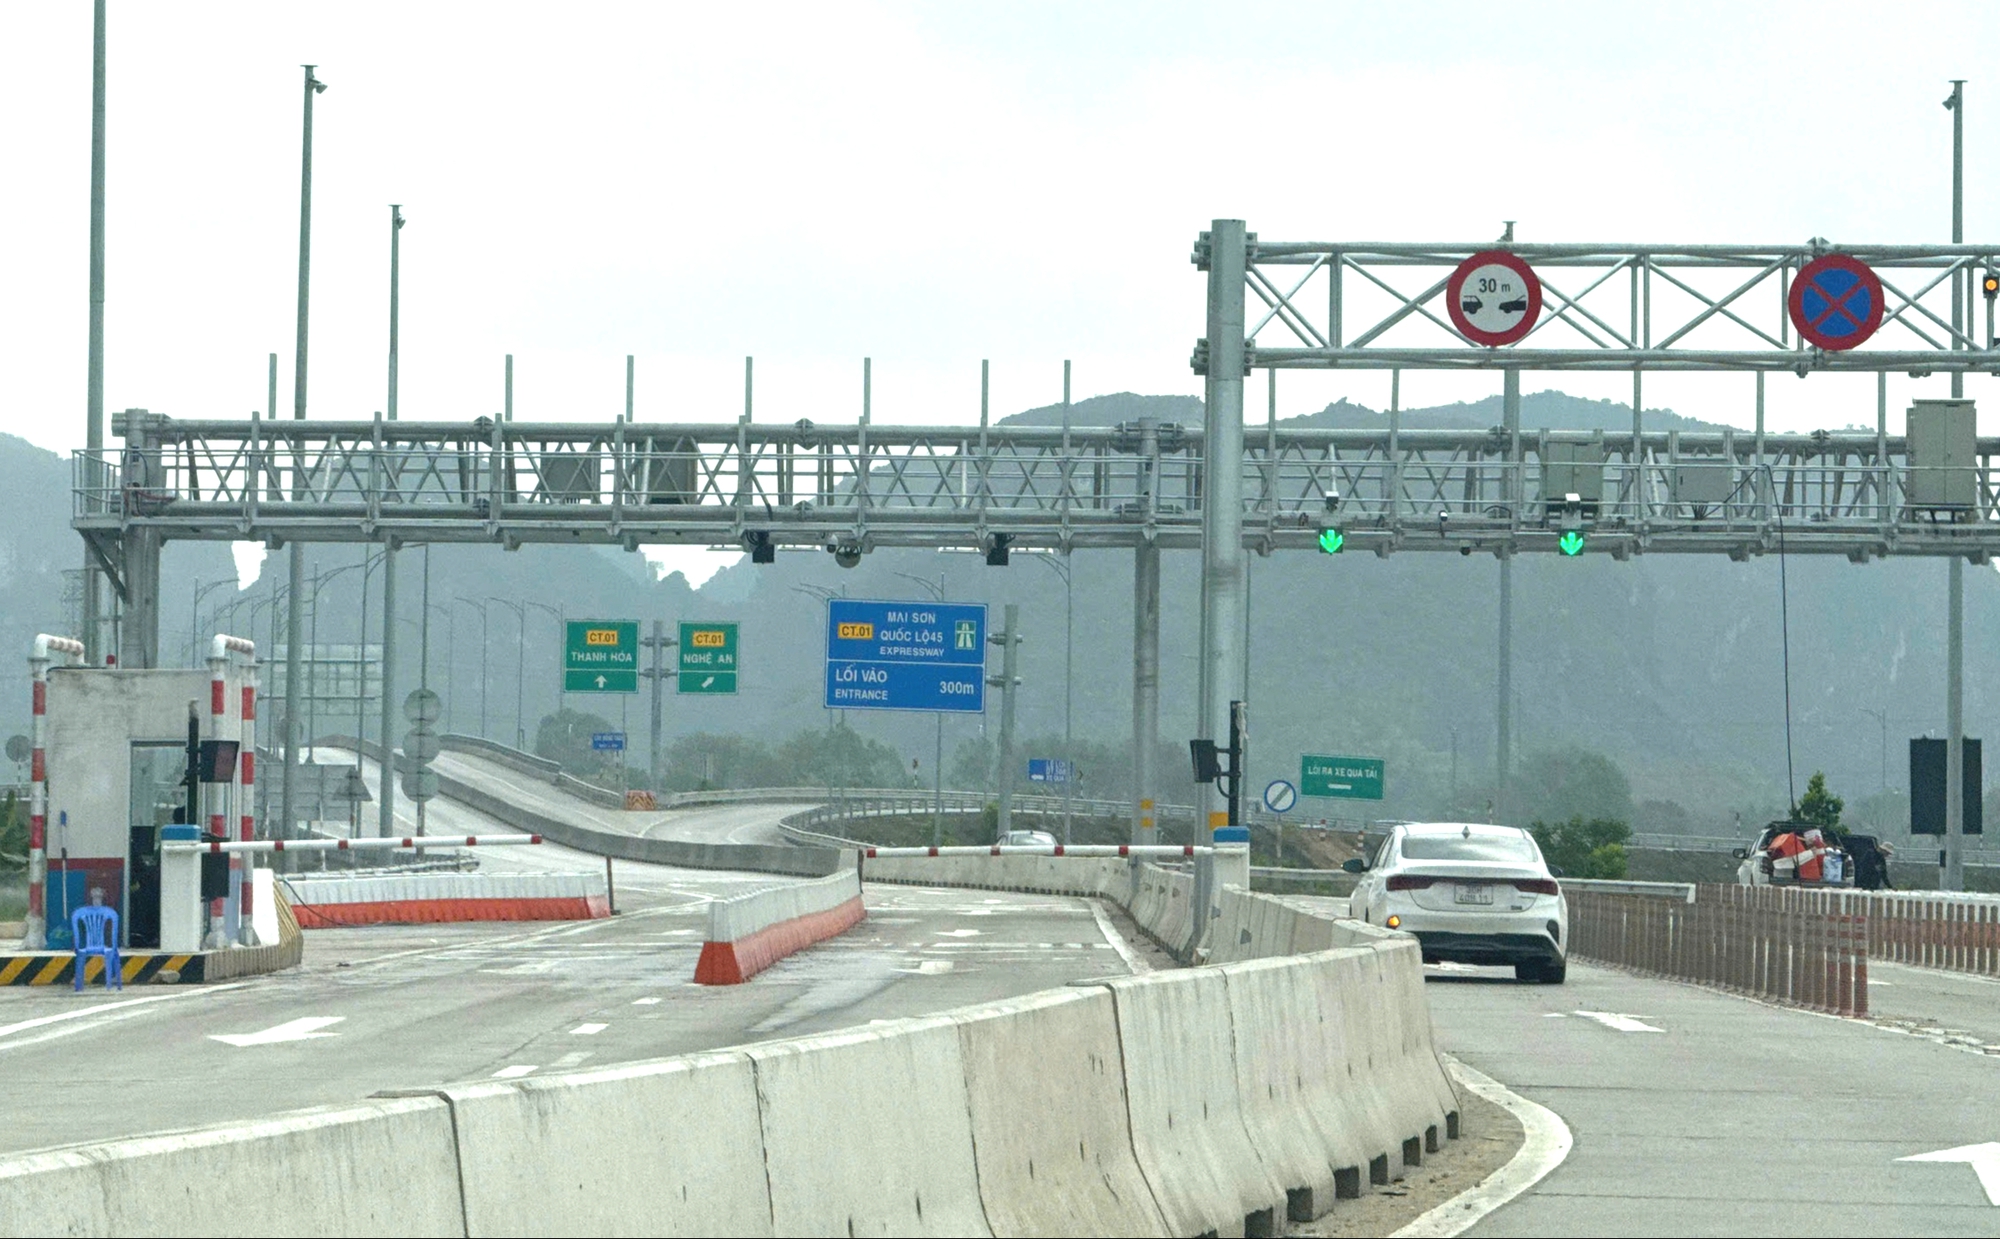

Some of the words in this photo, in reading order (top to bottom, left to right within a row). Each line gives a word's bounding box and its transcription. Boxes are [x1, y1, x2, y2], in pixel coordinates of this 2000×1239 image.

[1479, 278, 1497, 293] 30
[1501, 284, 1511, 292] m
[887, 611, 908, 623] MAI
[912, 611, 936, 623] SƠN
[841, 625, 871, 636] CT.01
[880, 627, 912, 642] QUỐC
[915, 631, 943, 645] LỘ45
[589, 631, 616, 642] CT.01
[695, 633, 722, 644] CT.01
[571, 651, 607, 662] THANH
[879, 646, 944, 657] EXPRESSWAY
[718, 654, 733, 664] AN
[835, 664, 858, 682] LỐI
[862, 667, 888, 683] VÀO
[939, 681, 975, 695] 300m
[835, 689, 888, 700] ENTRANCE
